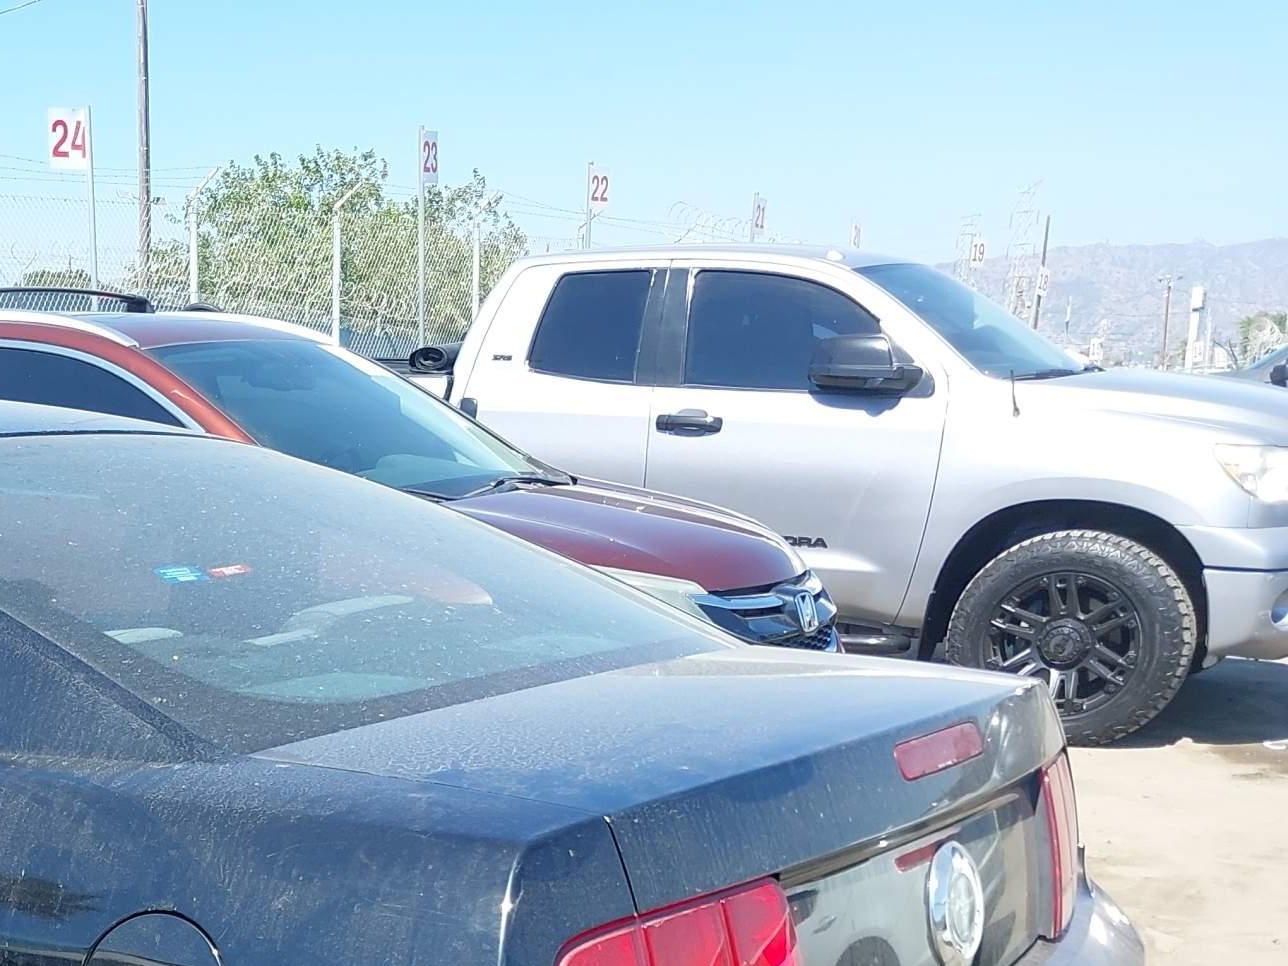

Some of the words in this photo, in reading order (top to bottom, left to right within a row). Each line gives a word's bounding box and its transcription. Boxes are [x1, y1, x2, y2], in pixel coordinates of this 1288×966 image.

[51, 119, 86, 159] 24
[423, 140, 438, 173] 23
[591, 174, 609, 202] 22
[755, 203, 766, 229] 21
[972, 242, 985, 263] 19
